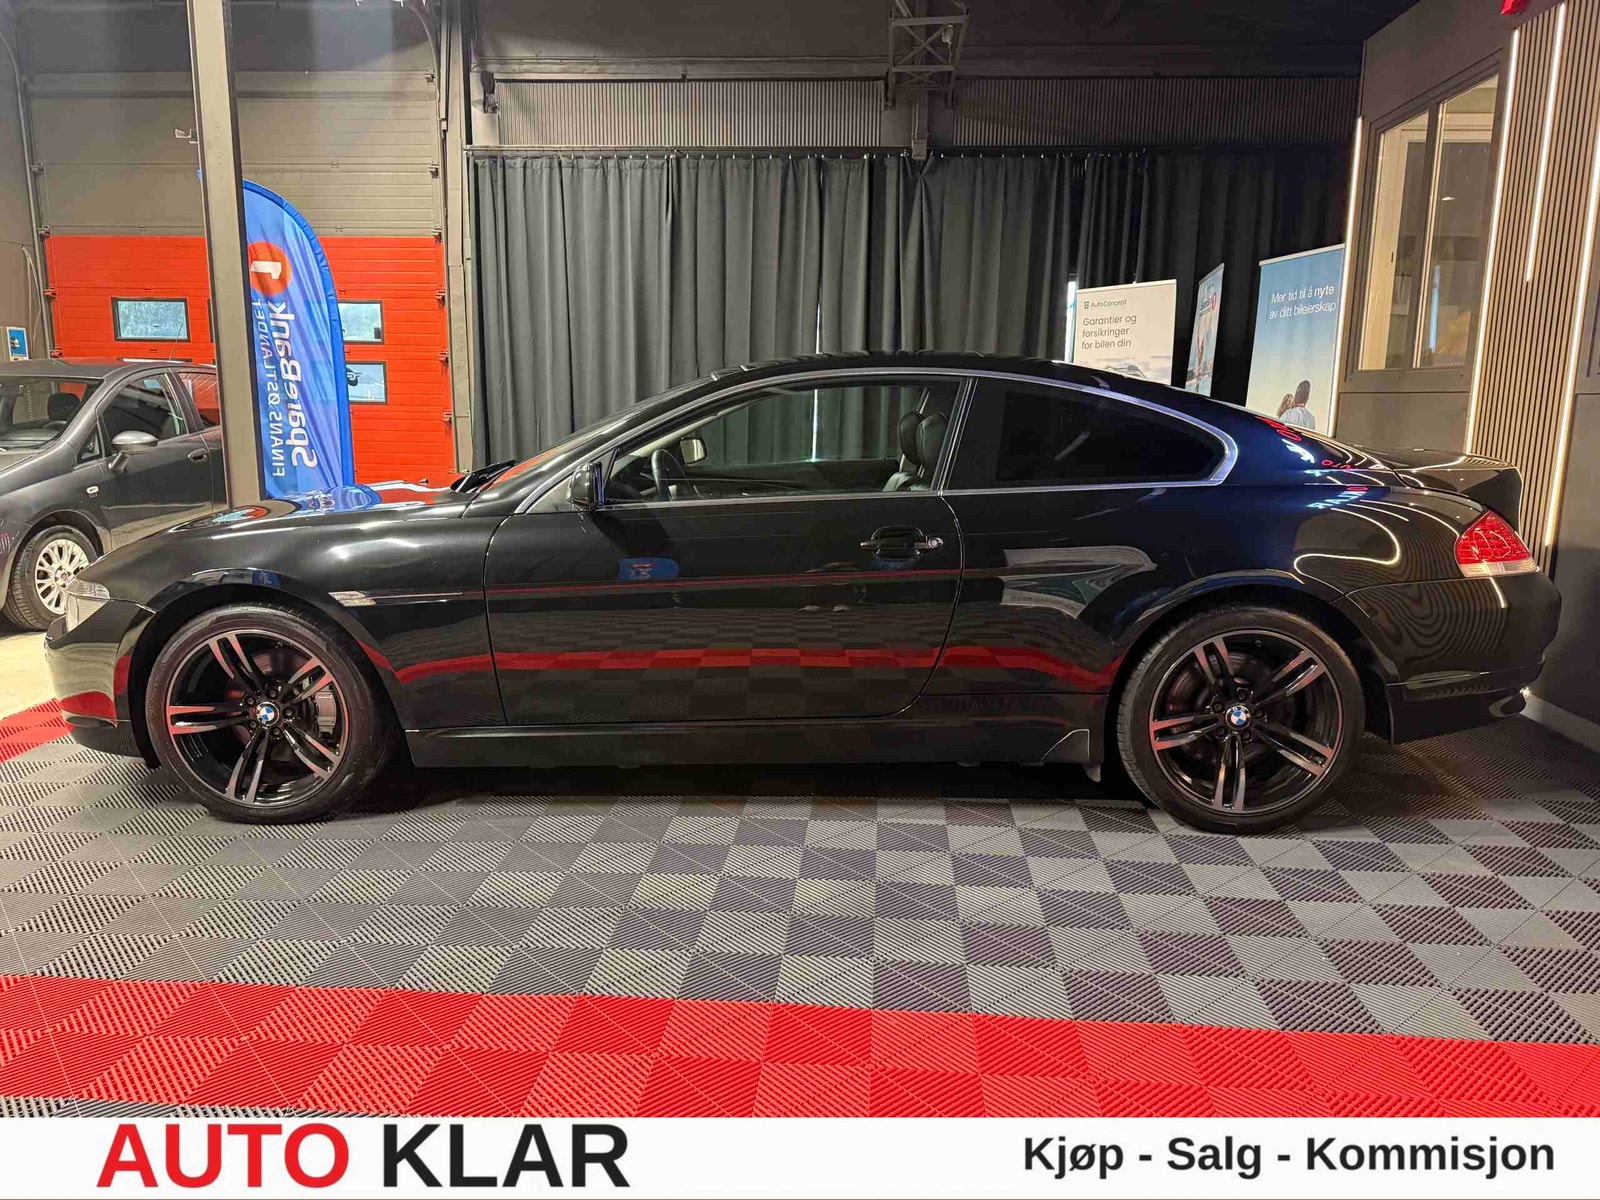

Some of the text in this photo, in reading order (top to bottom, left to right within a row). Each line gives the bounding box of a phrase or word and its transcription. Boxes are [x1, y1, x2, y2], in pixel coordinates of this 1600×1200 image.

[1271, 292, 1287, 304] Mer
[1288, 289, 1298, 301] tid
[1313, 285, 1335, 299] nyte
[1091, 299, 1127, 308] AutoConcept
[1269, 310, 1279, 320] av
[1279, 305, 1293, 318] ditt
[1082, 315, 1137, 326] Garantier og
[1082, 327, 1130, 338] forsikringer
[1081, 338, 1132, 350] for bilen din
